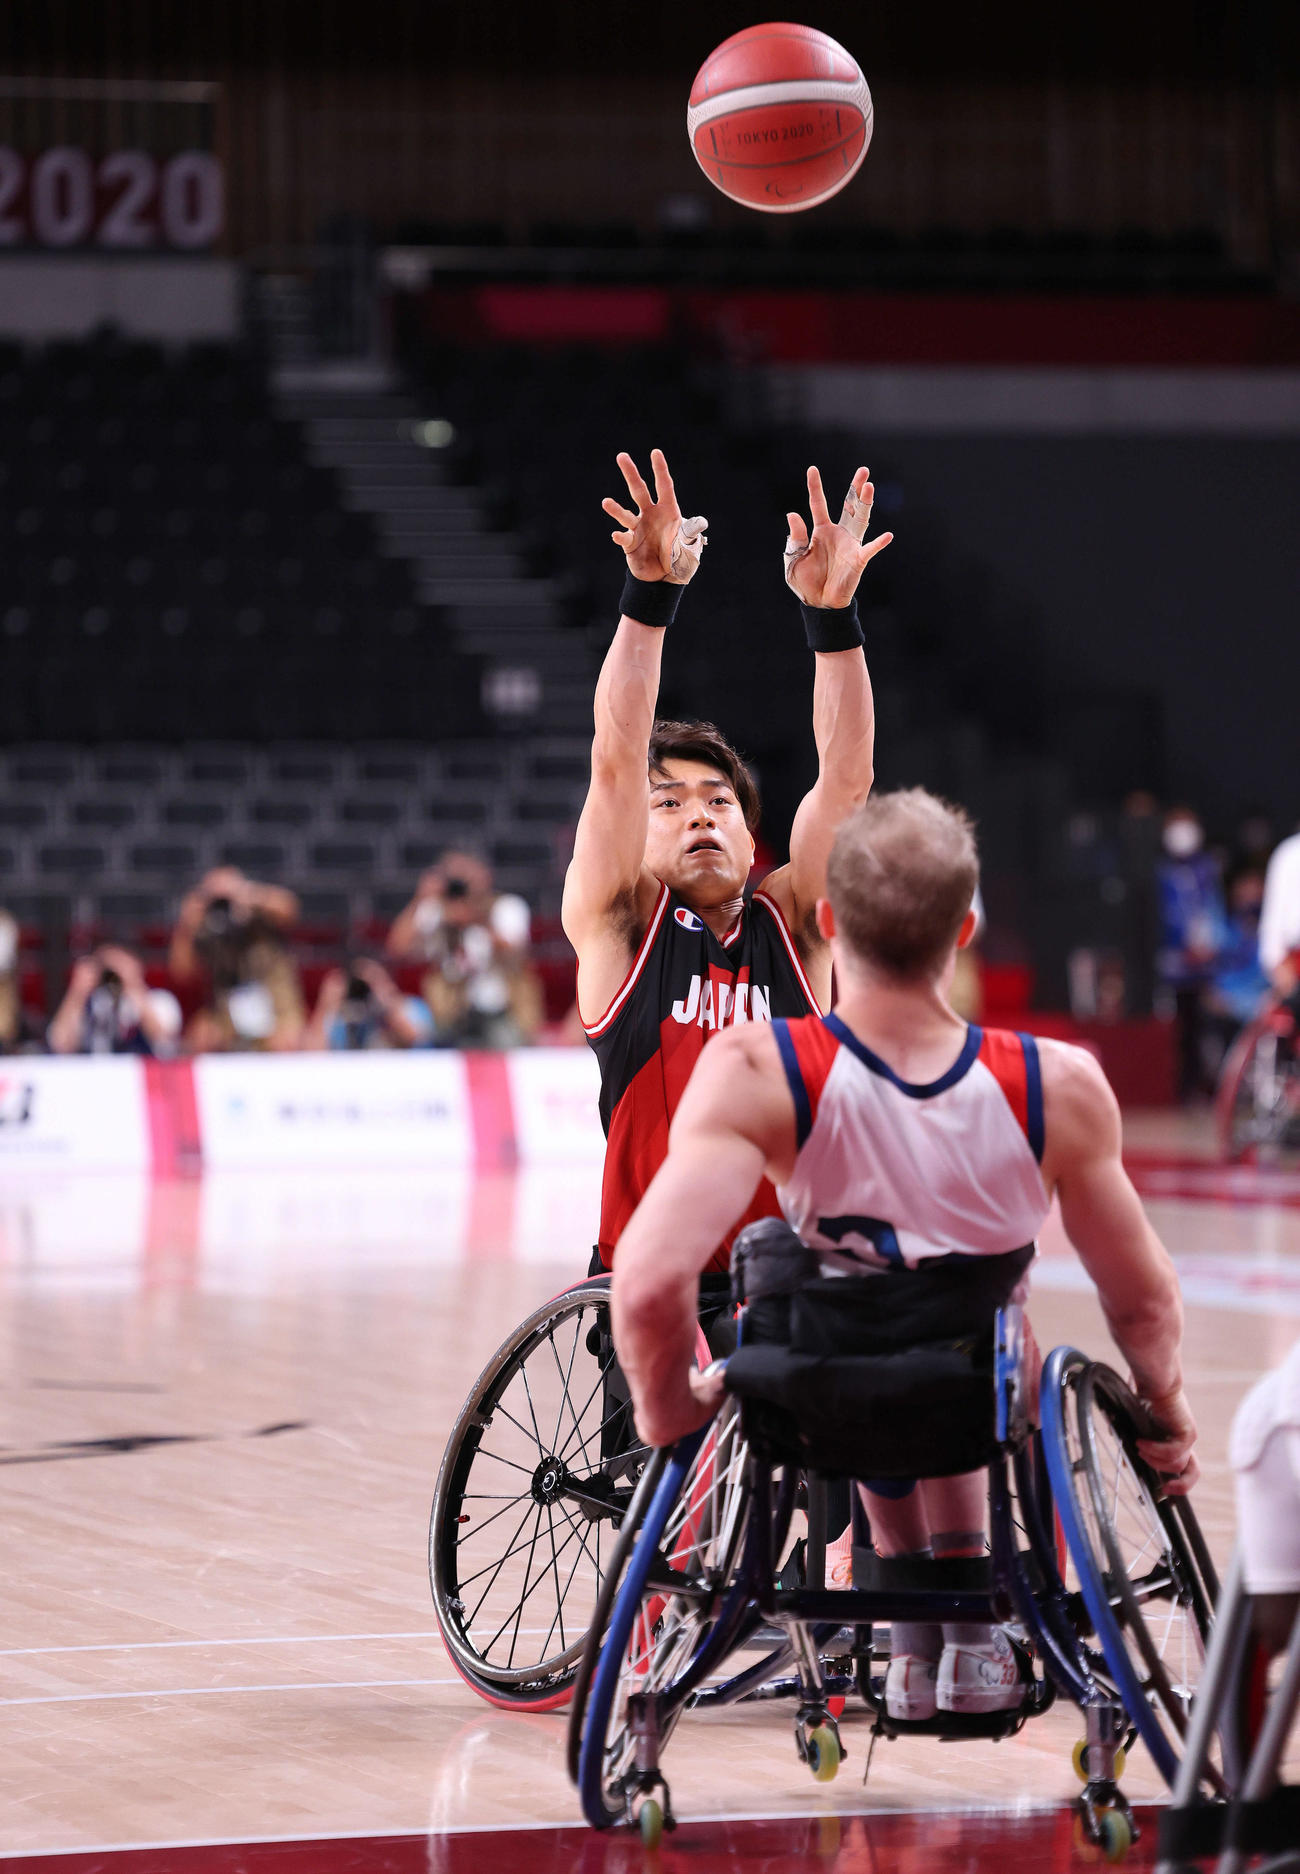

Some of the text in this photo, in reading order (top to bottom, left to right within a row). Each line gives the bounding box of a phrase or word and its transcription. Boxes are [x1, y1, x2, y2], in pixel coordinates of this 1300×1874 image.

[737, 123, 814, 145] TOKYO 2020
[671, 974, 773, 1031] JAPAN
